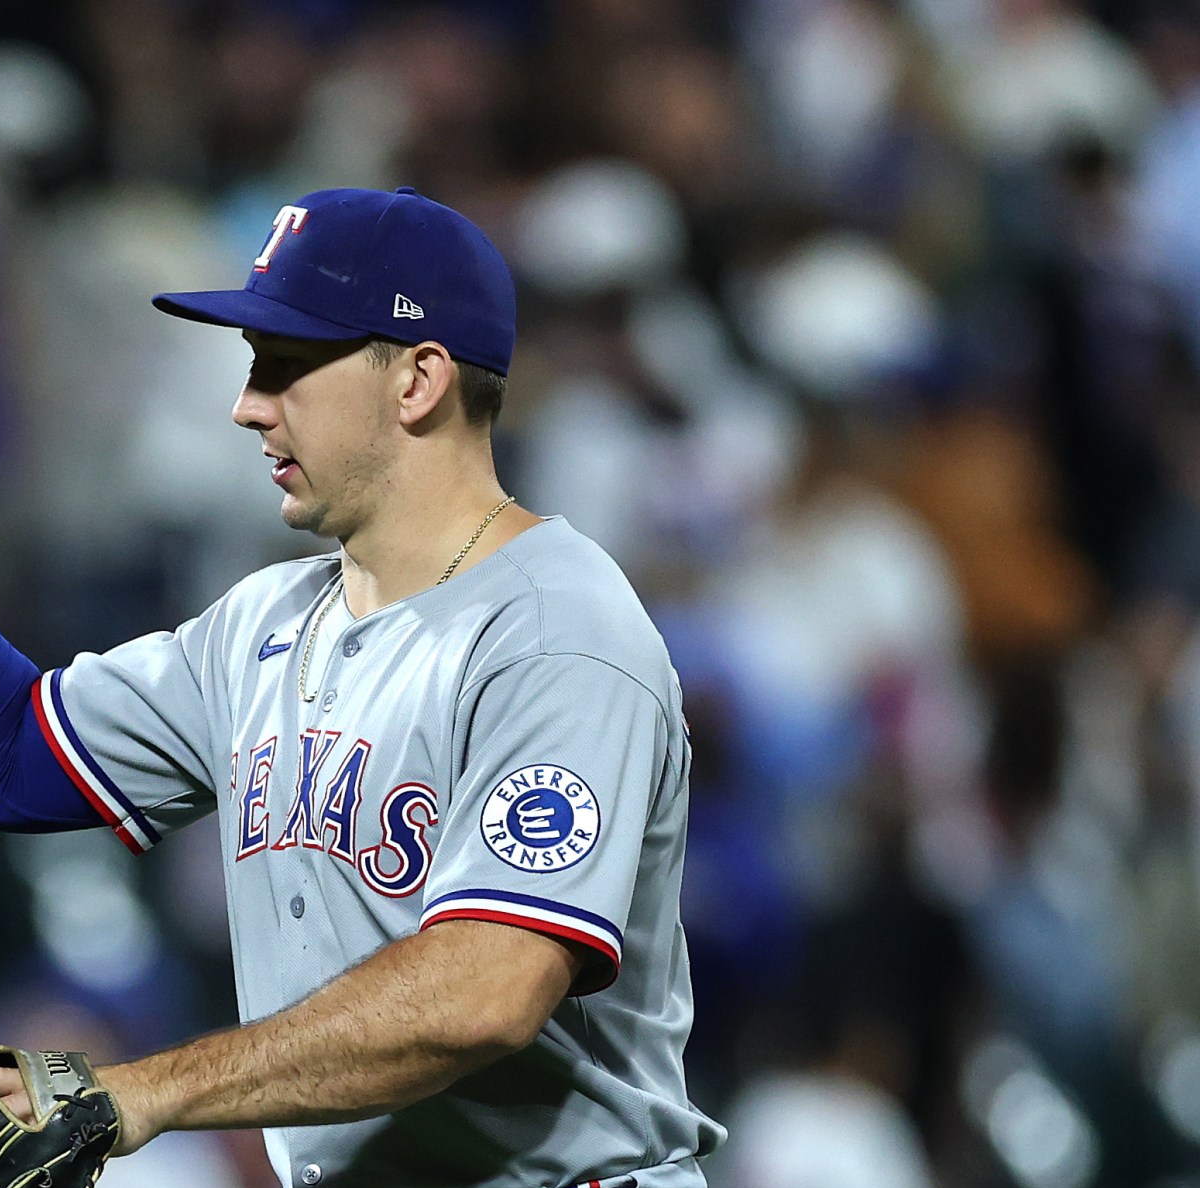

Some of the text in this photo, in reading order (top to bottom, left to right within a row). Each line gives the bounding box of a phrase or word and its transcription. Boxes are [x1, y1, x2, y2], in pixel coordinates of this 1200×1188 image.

[254, 205, 310, 273] T
[230, 728, 439, 898] EXAS
[496, 769, 594, 812] ENERGY
[486, 819, 593, 868] TRANSFER
